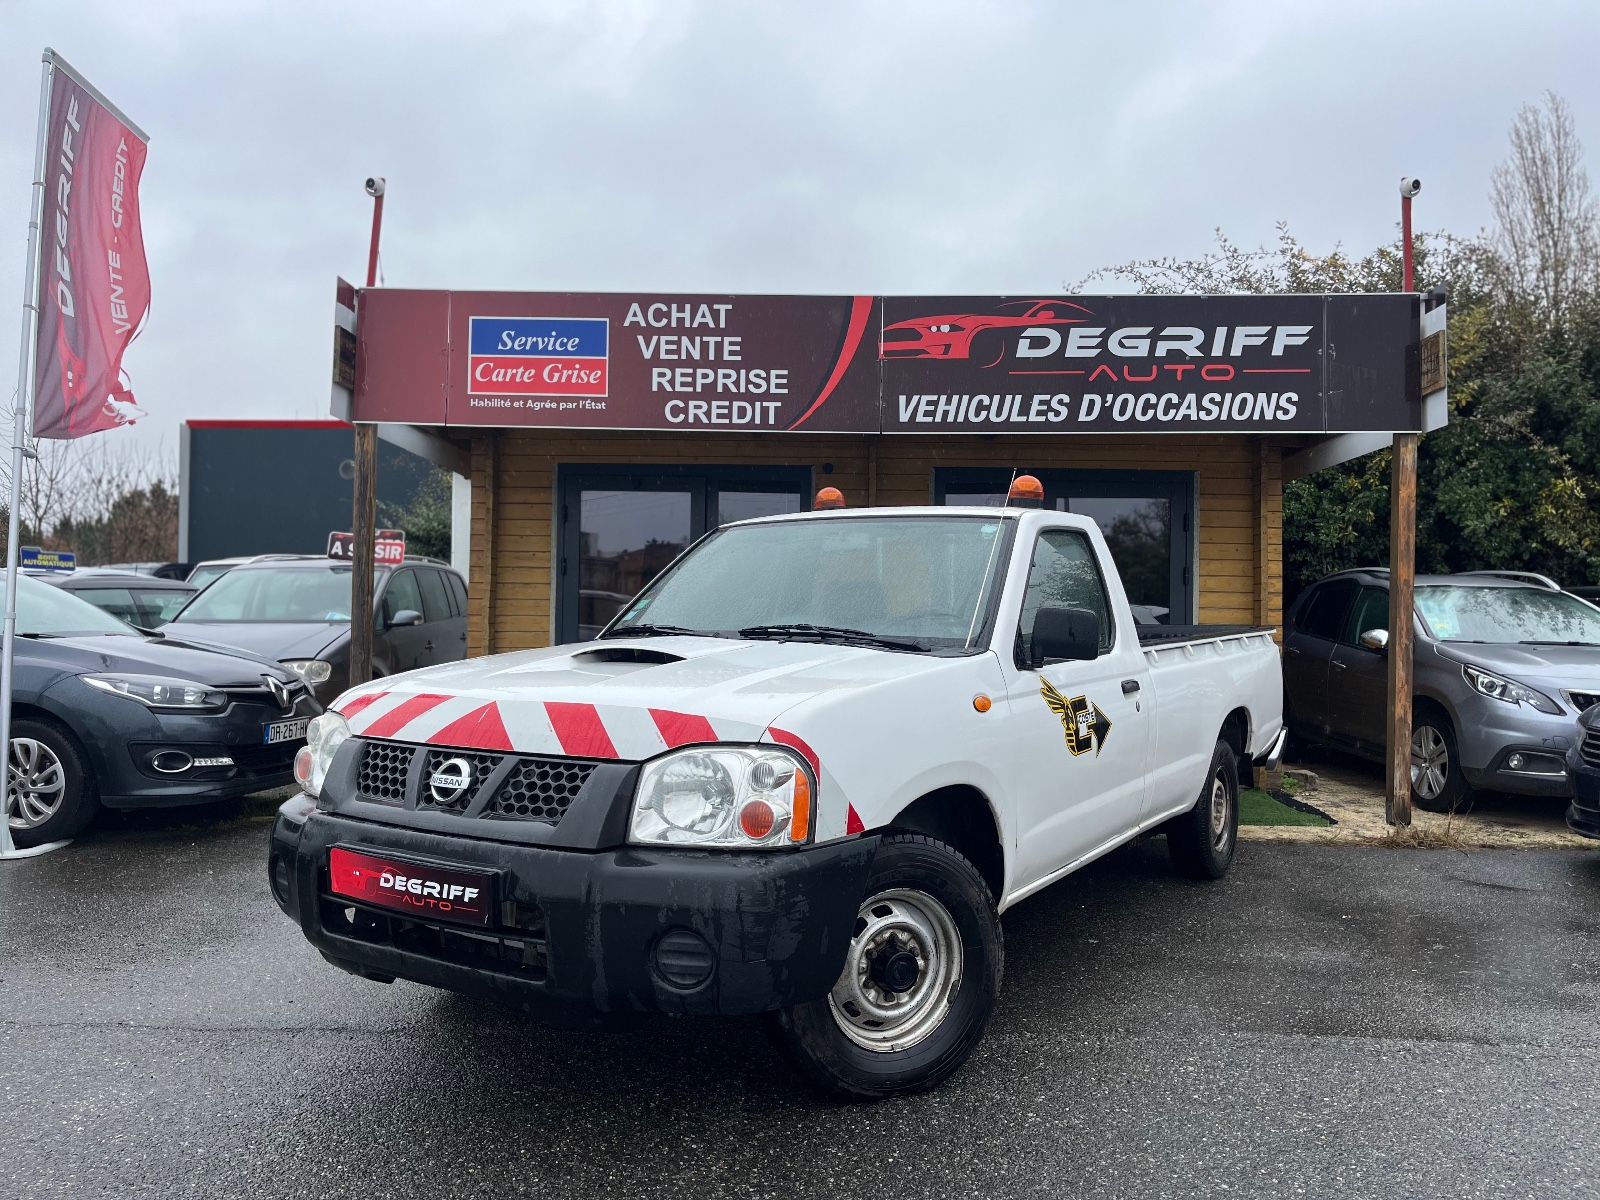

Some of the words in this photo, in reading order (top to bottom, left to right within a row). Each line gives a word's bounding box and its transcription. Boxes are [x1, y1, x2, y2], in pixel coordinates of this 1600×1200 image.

[111, 136, 130, 229] CREDIT
[56, 93, 81, 318] DEGRIFF
[110, 249, 132, 335] VENTE
[623, 302, 733, 329] ACHAT
[498, 330, 580, 351] Service
[636, 335, 742, 361] VENTE
[1015, 325, 1314, 358] DEGRIFF
[475, 362, 536, 383] Carte
[543, 363, 602, 384] Grise
[651, 367, 789, 394] REPRISE
[1088, 364, 1235, 382] AUTO
[470, 398, 511, 408] Habilité
[513, 399, 524, 408] et
[526, 399, 557, 411] Agrée
[559, 402, 576, 411] par
[579, 398, 606, 410] l'État
[664, 399, 782, 425] CREDIT
[898, 393, 1070, 423] VEHICULES
[1078, 391, 1299, 423] D'OCCASIONS
[330, 541, 343, 556] A
[23, 558, 74, 568] AUTOMATIQUE
[431, 776, 463, 788] NISSAN
[379, 872, 480, 903] DEGRIFF
[402, 894, 452, 911] AUTO
